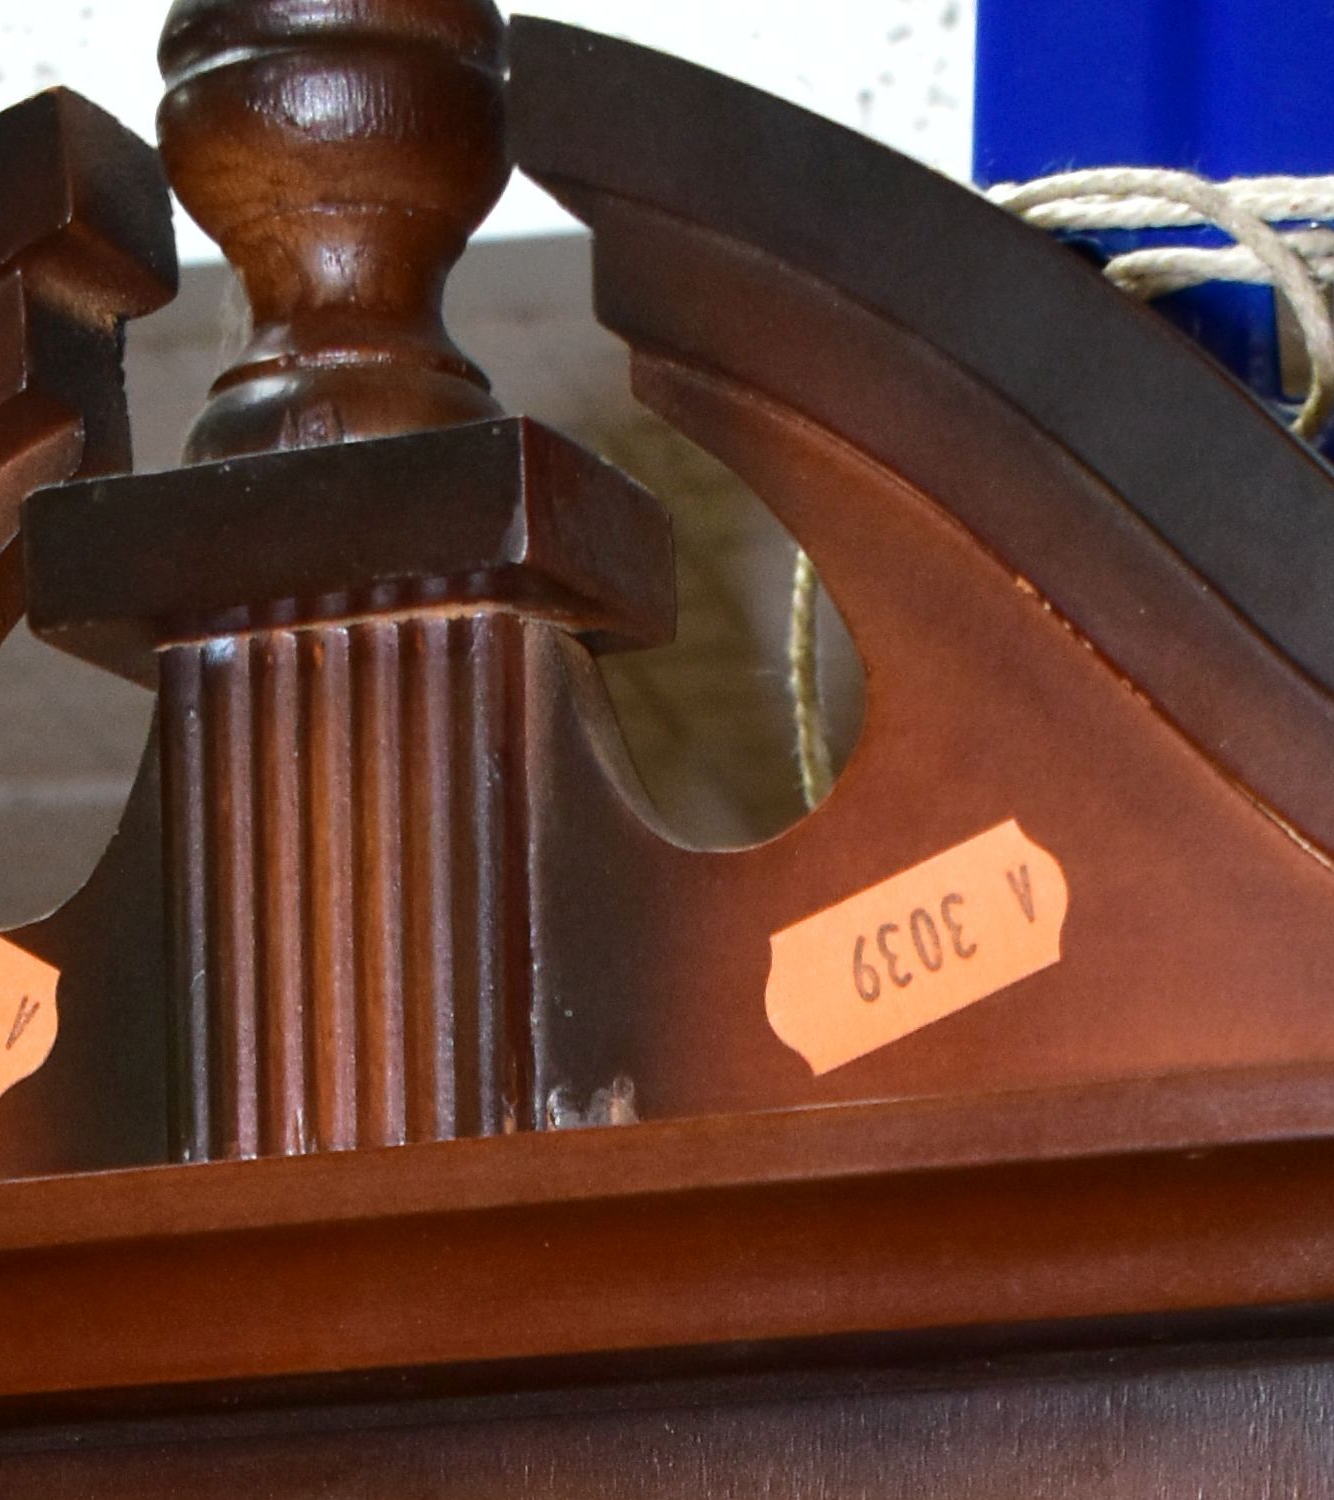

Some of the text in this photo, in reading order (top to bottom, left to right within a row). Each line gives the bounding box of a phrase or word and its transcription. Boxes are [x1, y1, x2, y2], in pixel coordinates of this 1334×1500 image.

[853, 864, 1036, 1003] A 3039
[5, 996, 41, 1050] A
